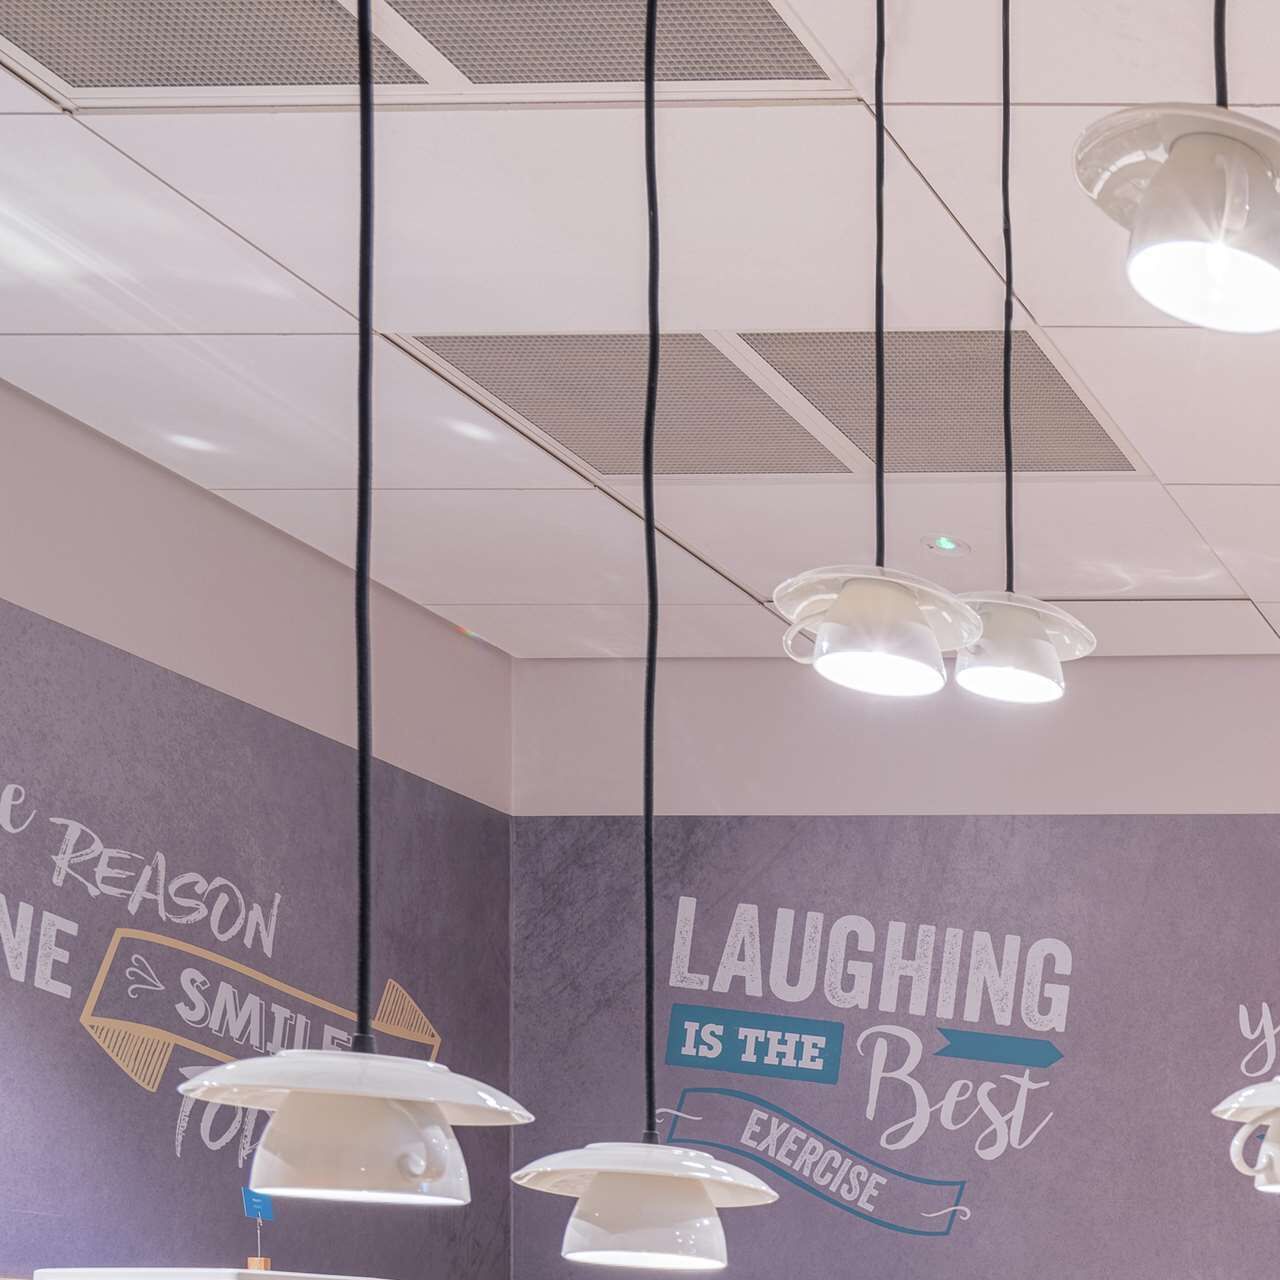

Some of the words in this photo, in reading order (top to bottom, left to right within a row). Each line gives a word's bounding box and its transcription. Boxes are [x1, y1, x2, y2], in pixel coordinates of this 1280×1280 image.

[49, 816, 281, 958] REASON
[669, 895, 1073, 1033] LAUGHING
[680, 1020, 724, 1059] IS
[737, 1026, 827, 1070] THE
[855, 1024, 1053, 1160] Best
[739, 1108, 887, 1212] EXERCISE
